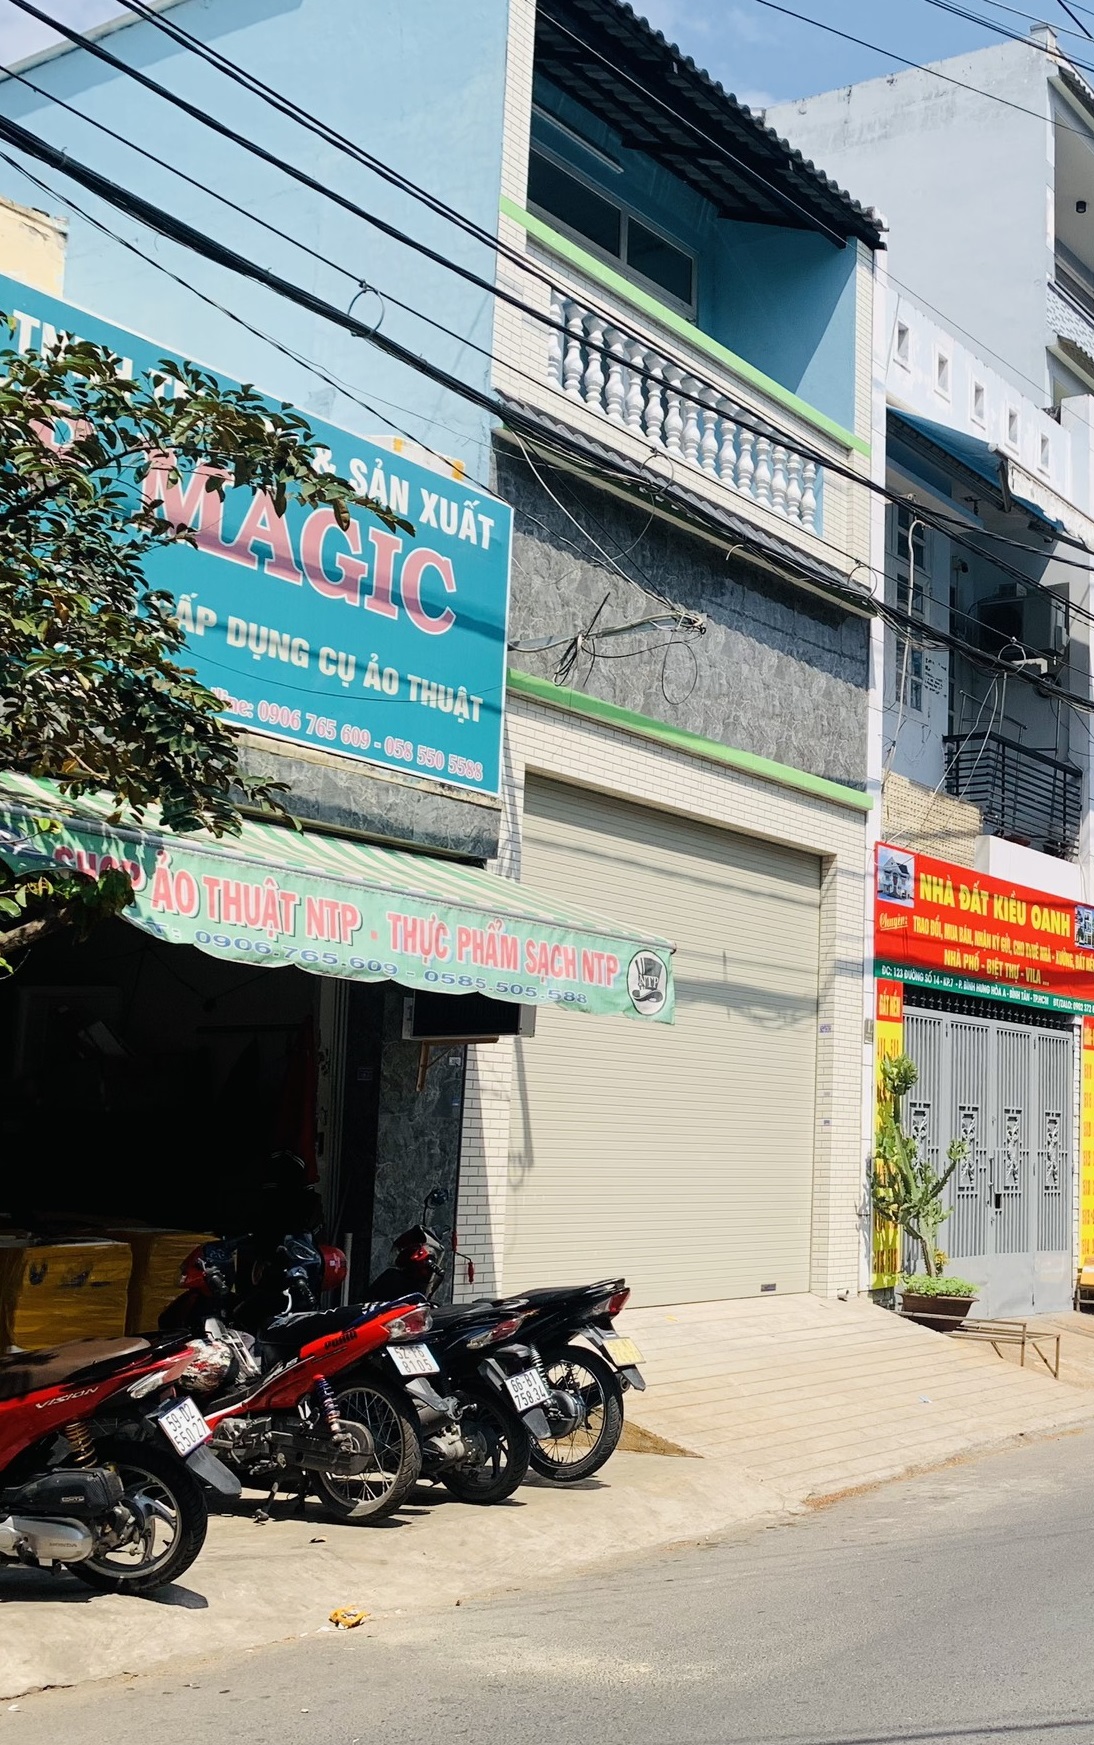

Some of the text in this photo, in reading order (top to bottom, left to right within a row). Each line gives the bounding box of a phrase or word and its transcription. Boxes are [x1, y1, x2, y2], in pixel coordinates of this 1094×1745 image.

[13, 309, 133, 400] TNH
[350, 458, 410, 516] SẢN
[419, 487, 495, 550] XUẤT
[131, 447, 457, 635] MAGIC
[158, 592, 483, 723] ẤP DỤNG CỤ ẢO THUẬT
[258, 700, 302, 731] 0906
[305, 713, 337, 740] 765
[341, 724, 371, 750] 609
[384, 736, 413, 762] 058
[417, 745, 445, 770] 550
[448, 753, 484, 782] 5588
[151, 849, 200, 918] ẢO
[202, 873, 300, 940] THUẬT
[306, 895, 362, 946] NTP
[386, 910, 450, 965] THỰC
[456, 918, 520, 973] PHẨM
[525, 938, 578, 984] SẠCH
[582, 949, 622, 989] NTP
[913, 915, 929, 936] TRAO
[944, 922, 958, 941] MUA
[919, 872, 1071, 938] NHÀ ĐẤT KIỀU OANH
[195, 929, 398, 976] 0906.765.609
[424, 969, 588, 1004] 0585.505.588
[639, 973, 659, 990] NTP
[881, 964, 893, 977] ĐC:
[893, 967, 904, 979] 123
[925, 970, 933, 984] SỐ
[933, 975, 940, 985] 14
[944, 948, 961, 969] NHÀ
[963, 951, 980, 972] PHỐ
[986, 957, 1003, 979] BIỆT
[1005, 962, 1020, 983] THỰ
[1025, 967, 1041, 985] VILA
[36, 1387, 98, 1409] VISION
[402, 1359, 433, 1373] 8105
